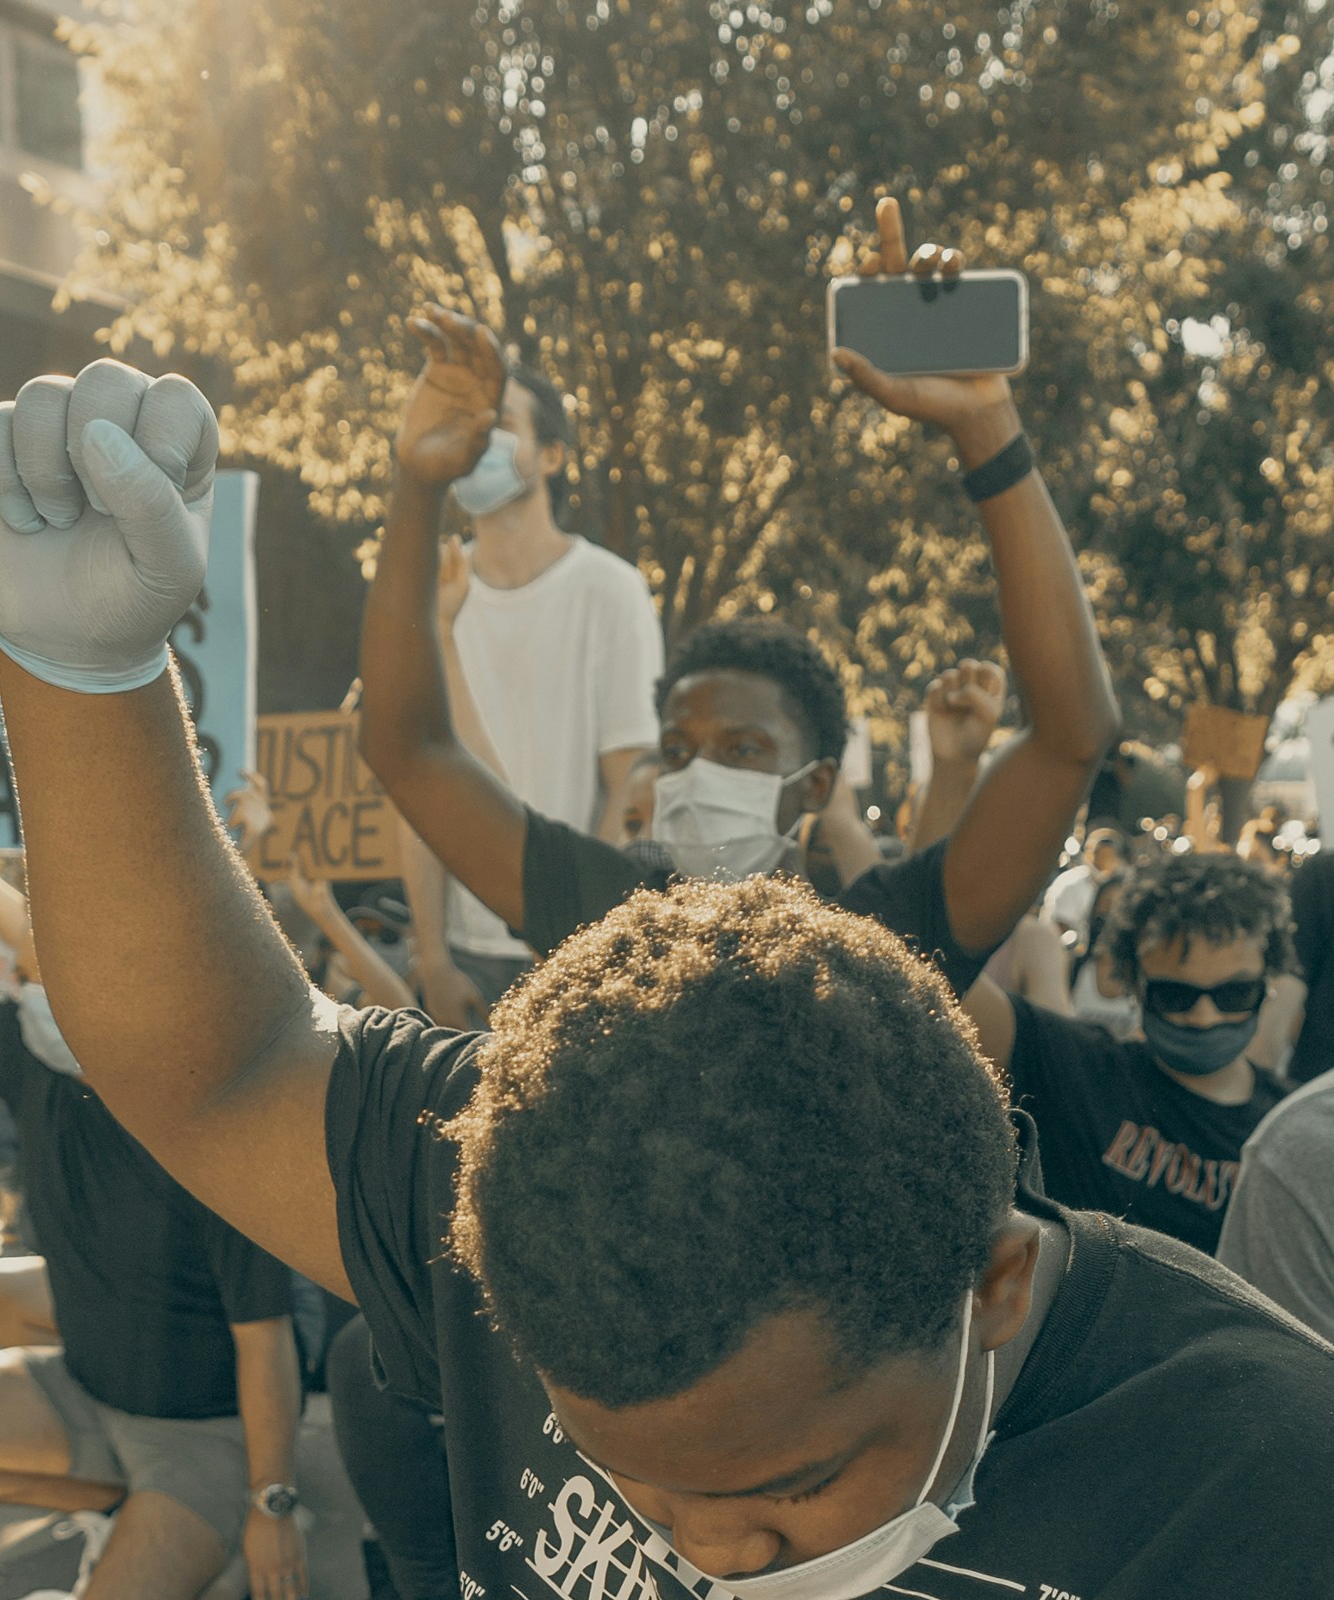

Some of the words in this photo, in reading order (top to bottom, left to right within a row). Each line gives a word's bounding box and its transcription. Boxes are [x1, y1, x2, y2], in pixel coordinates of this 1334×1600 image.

[260, 799, 384, 870] EACE
[520, 1467, 545, 1499] 6'0"
[485, 1519, 524, 1552] 5'6"
